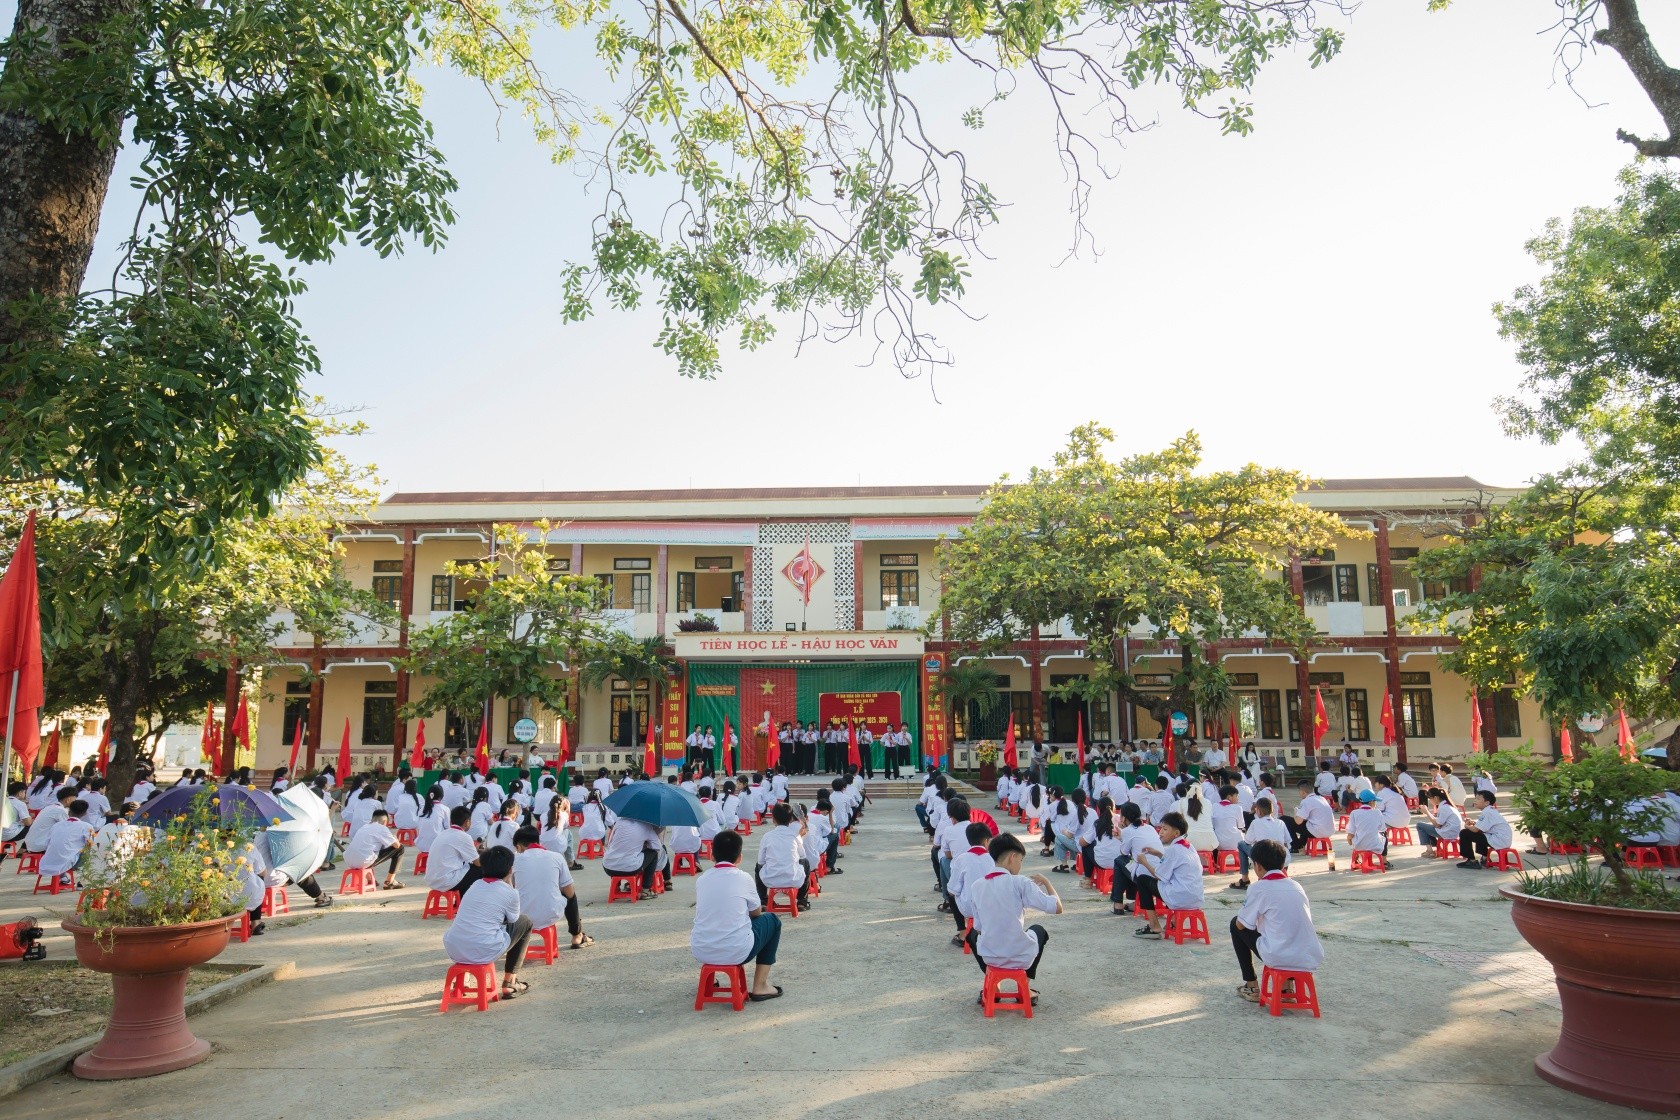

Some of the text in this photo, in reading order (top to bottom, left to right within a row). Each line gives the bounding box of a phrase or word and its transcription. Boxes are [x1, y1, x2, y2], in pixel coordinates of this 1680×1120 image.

[736, 640, 767, 652] HỌC
[801, 637, 831, 652] HẬU
[836, 640, 865, 652] HỌC
[869, 636, 898, 649] VĂN
